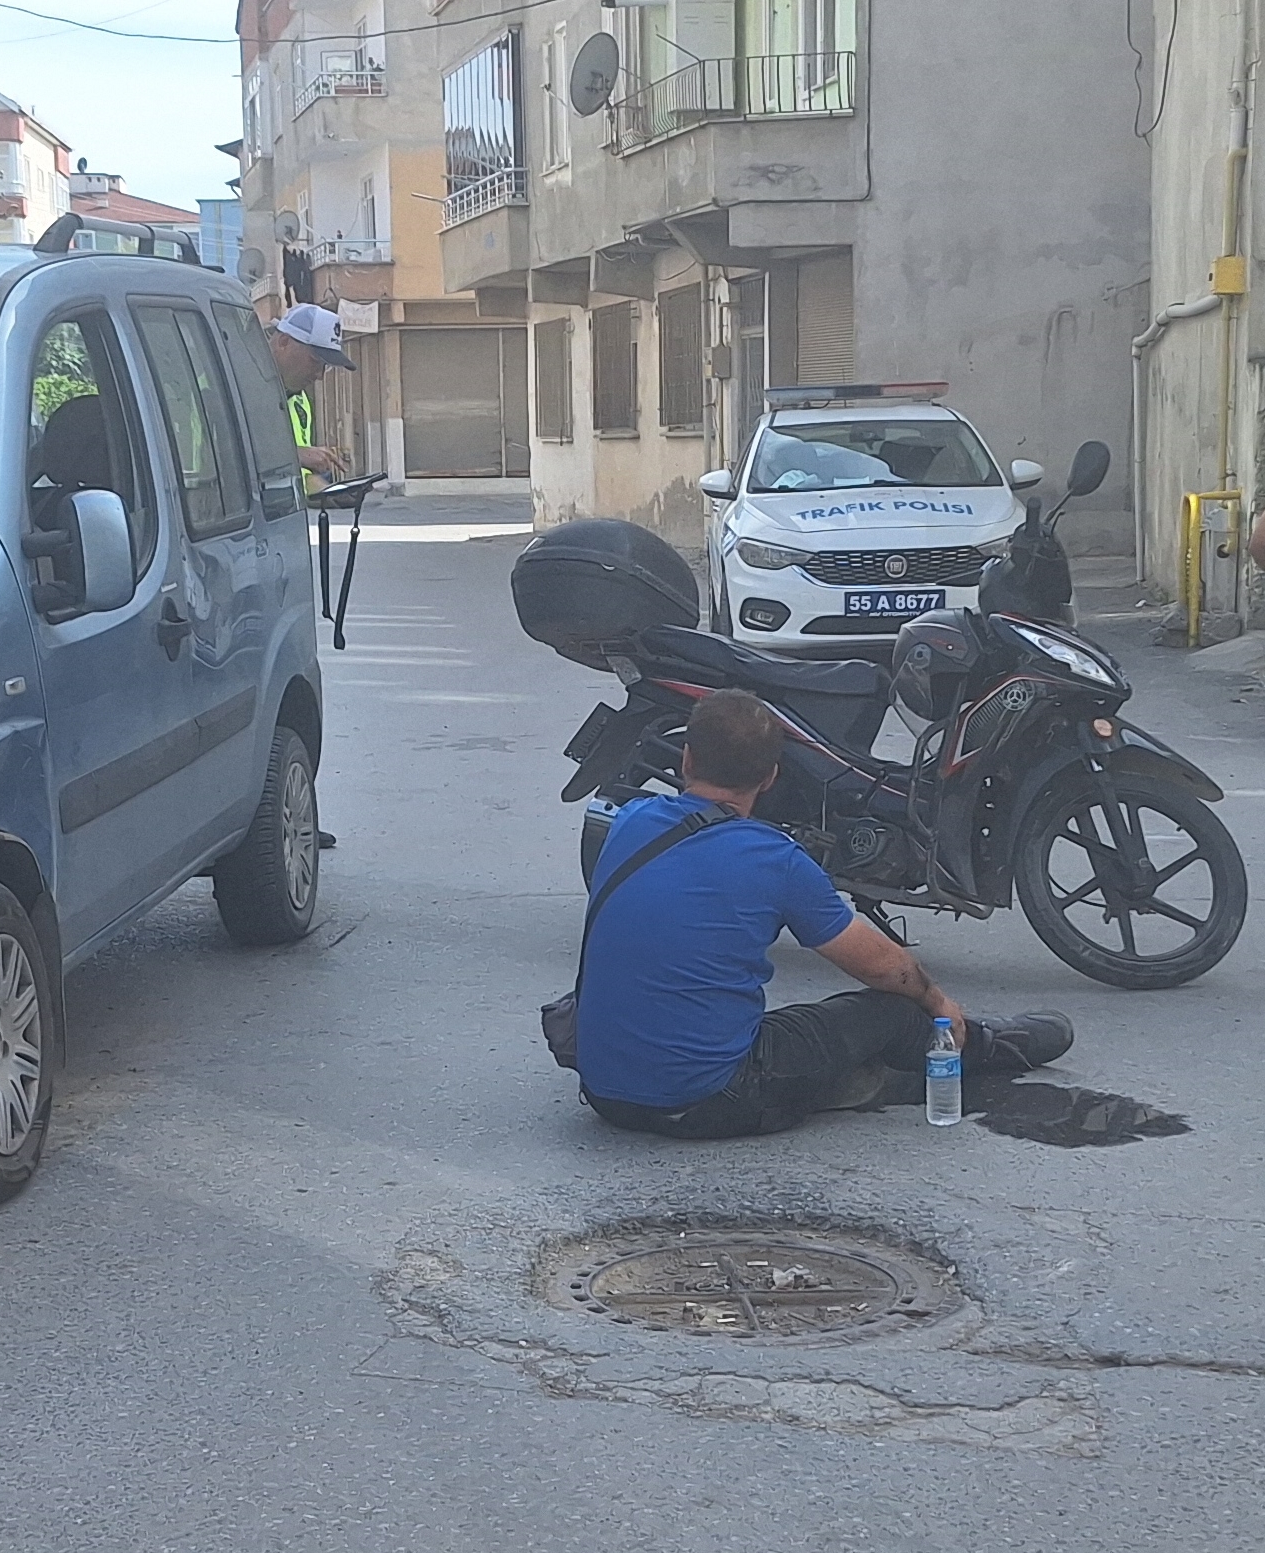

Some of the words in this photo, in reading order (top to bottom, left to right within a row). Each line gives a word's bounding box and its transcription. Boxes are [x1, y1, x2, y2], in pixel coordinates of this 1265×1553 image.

[849, 595, 872, 611] 55
[876, 595, 890, 610] A
[895, 593, 940, 610] 8677
